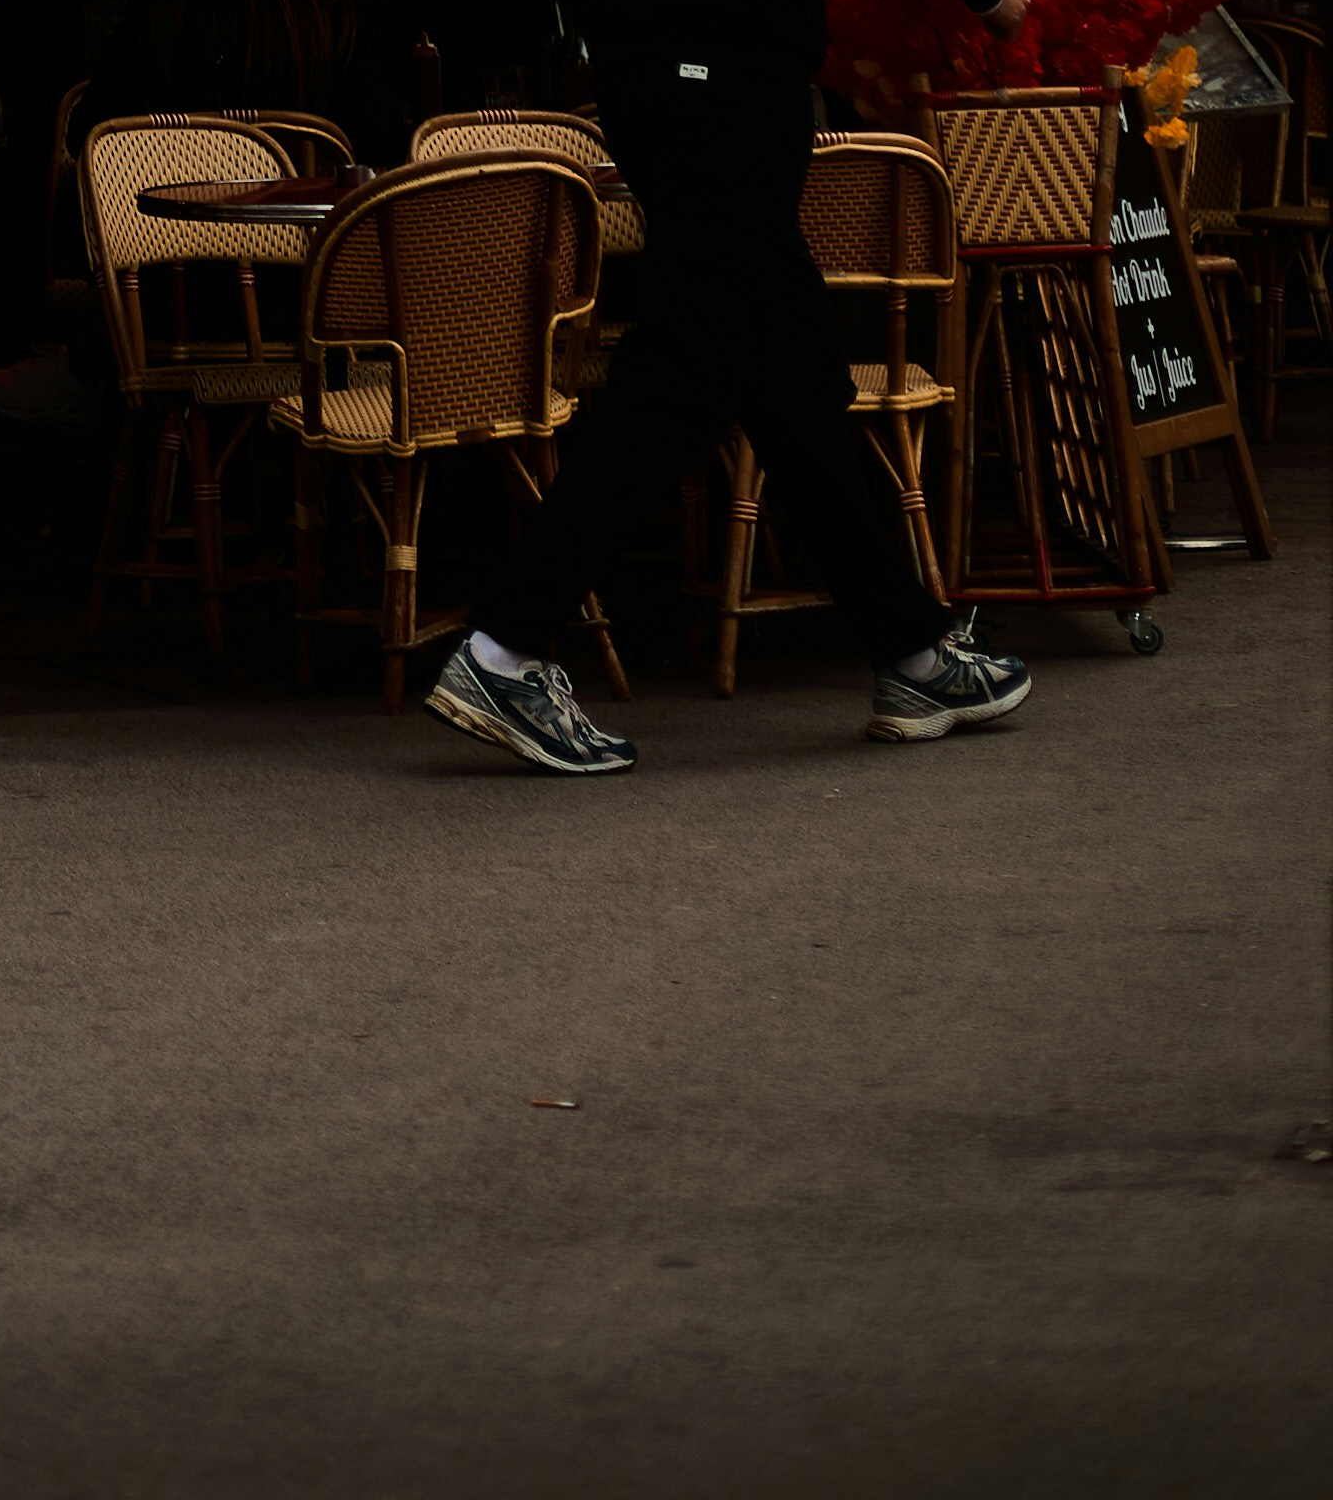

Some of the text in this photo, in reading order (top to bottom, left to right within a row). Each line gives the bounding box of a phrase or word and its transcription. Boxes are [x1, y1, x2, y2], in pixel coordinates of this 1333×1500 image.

[1121, 196, 1171, 244] Chaude
[1129, 256, 1172, 303] Drink
[1130, 353, 1157, 411] Jus
[1162, 346, 1197, 403] Juice
